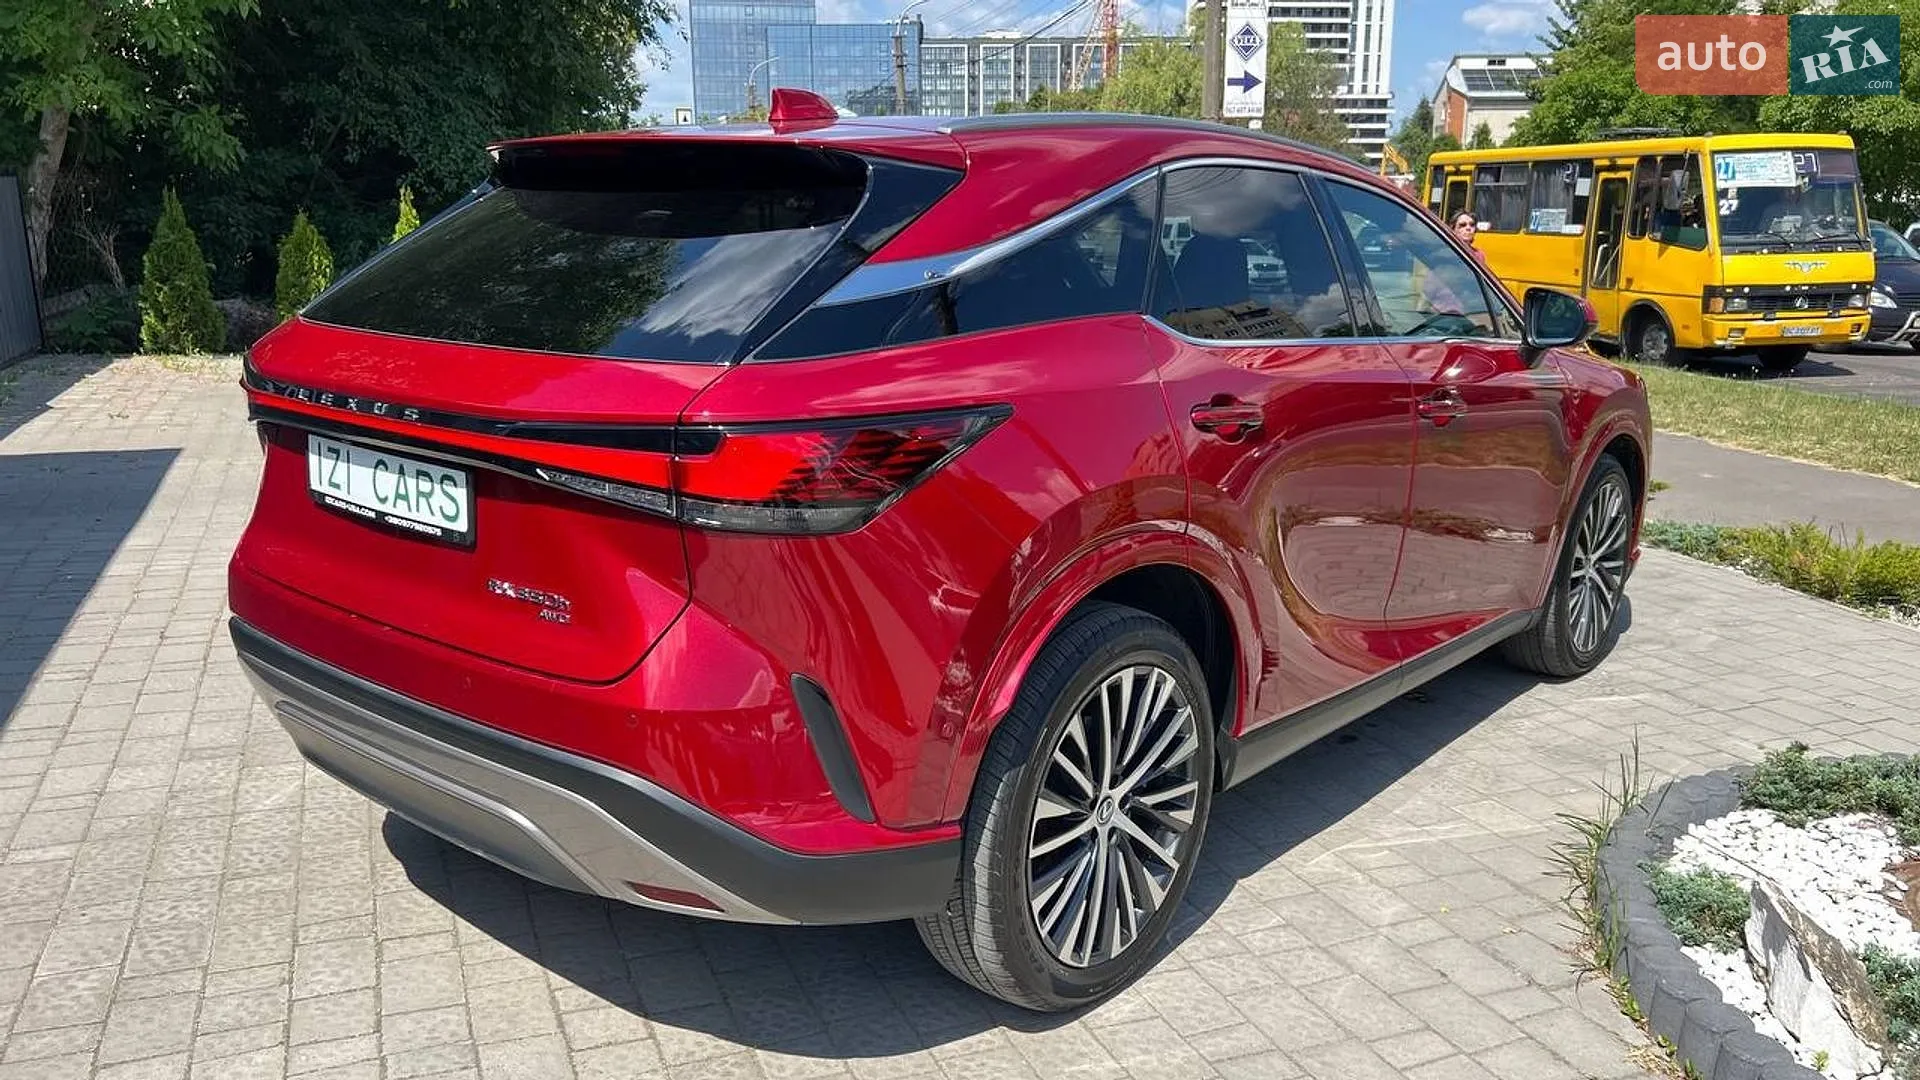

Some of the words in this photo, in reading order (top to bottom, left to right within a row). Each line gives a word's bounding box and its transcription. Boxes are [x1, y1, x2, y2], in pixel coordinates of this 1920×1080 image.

[1793, 152, 1818, 174] 27
[1718, 199, 1738, 216] 27
[297, 387, 421, 422] LEXUS
[316, 440, 352, 496] IZI
[372, 457, 461, 524] CARS
